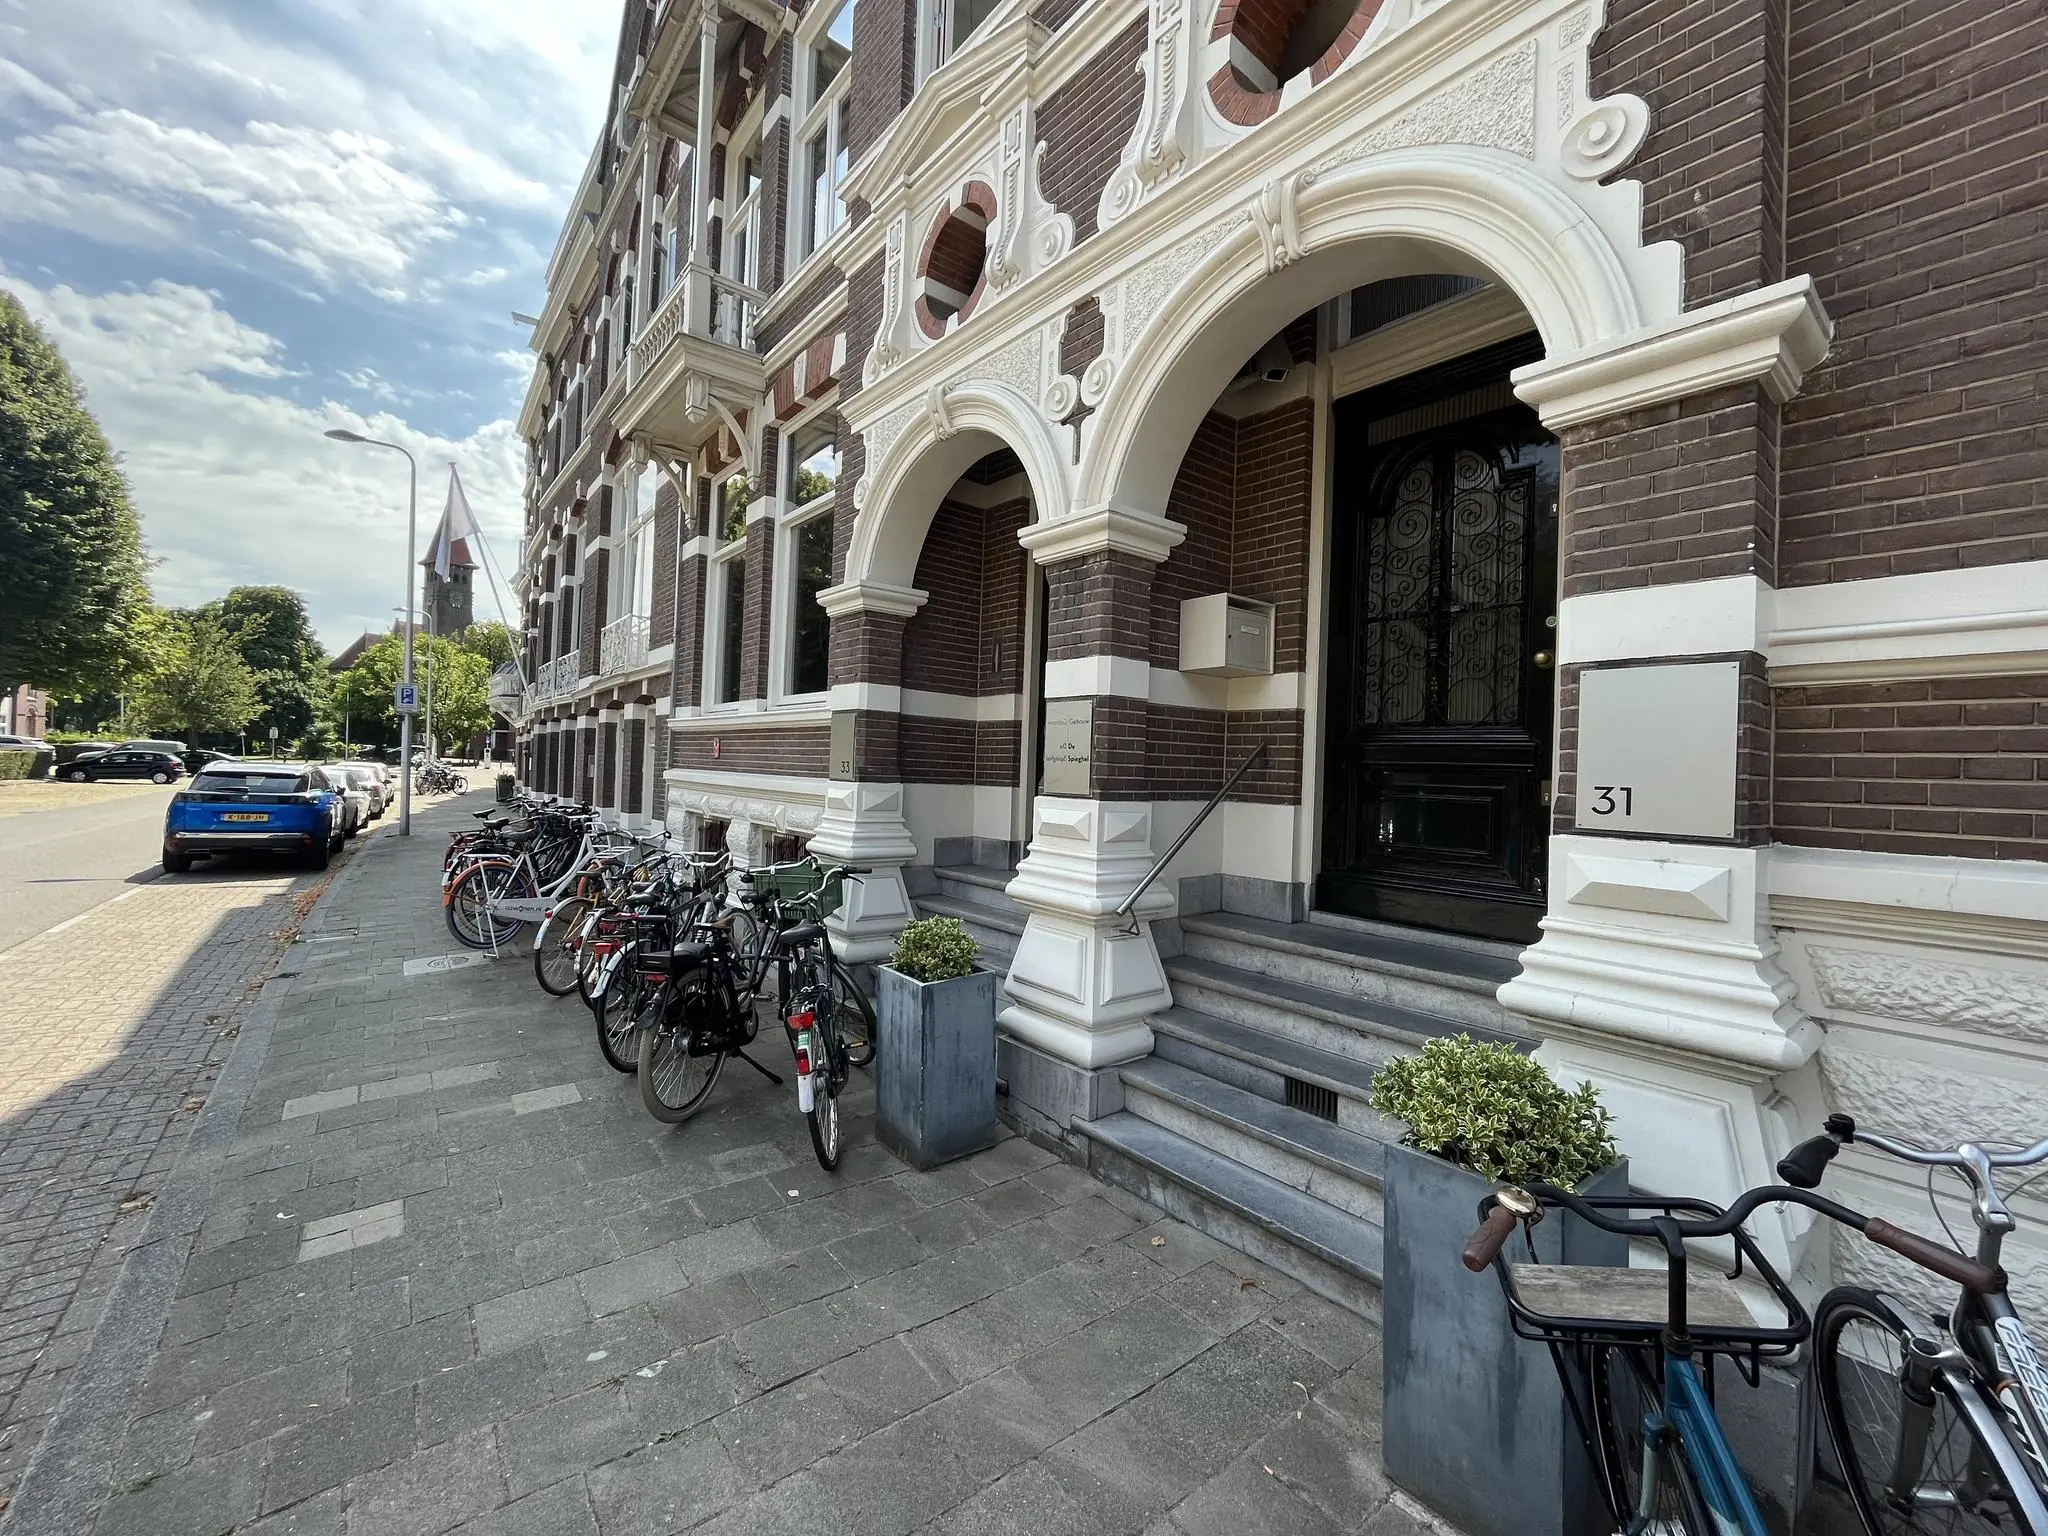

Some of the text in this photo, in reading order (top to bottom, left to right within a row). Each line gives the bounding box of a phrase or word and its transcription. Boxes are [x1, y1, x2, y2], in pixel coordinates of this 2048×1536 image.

[403, 690, 411, 698] P
[1068, 755, 1090, 764] Spieghel
[841, 761, 850, 773] 33
[1591, 786, 1632, 816] 31
